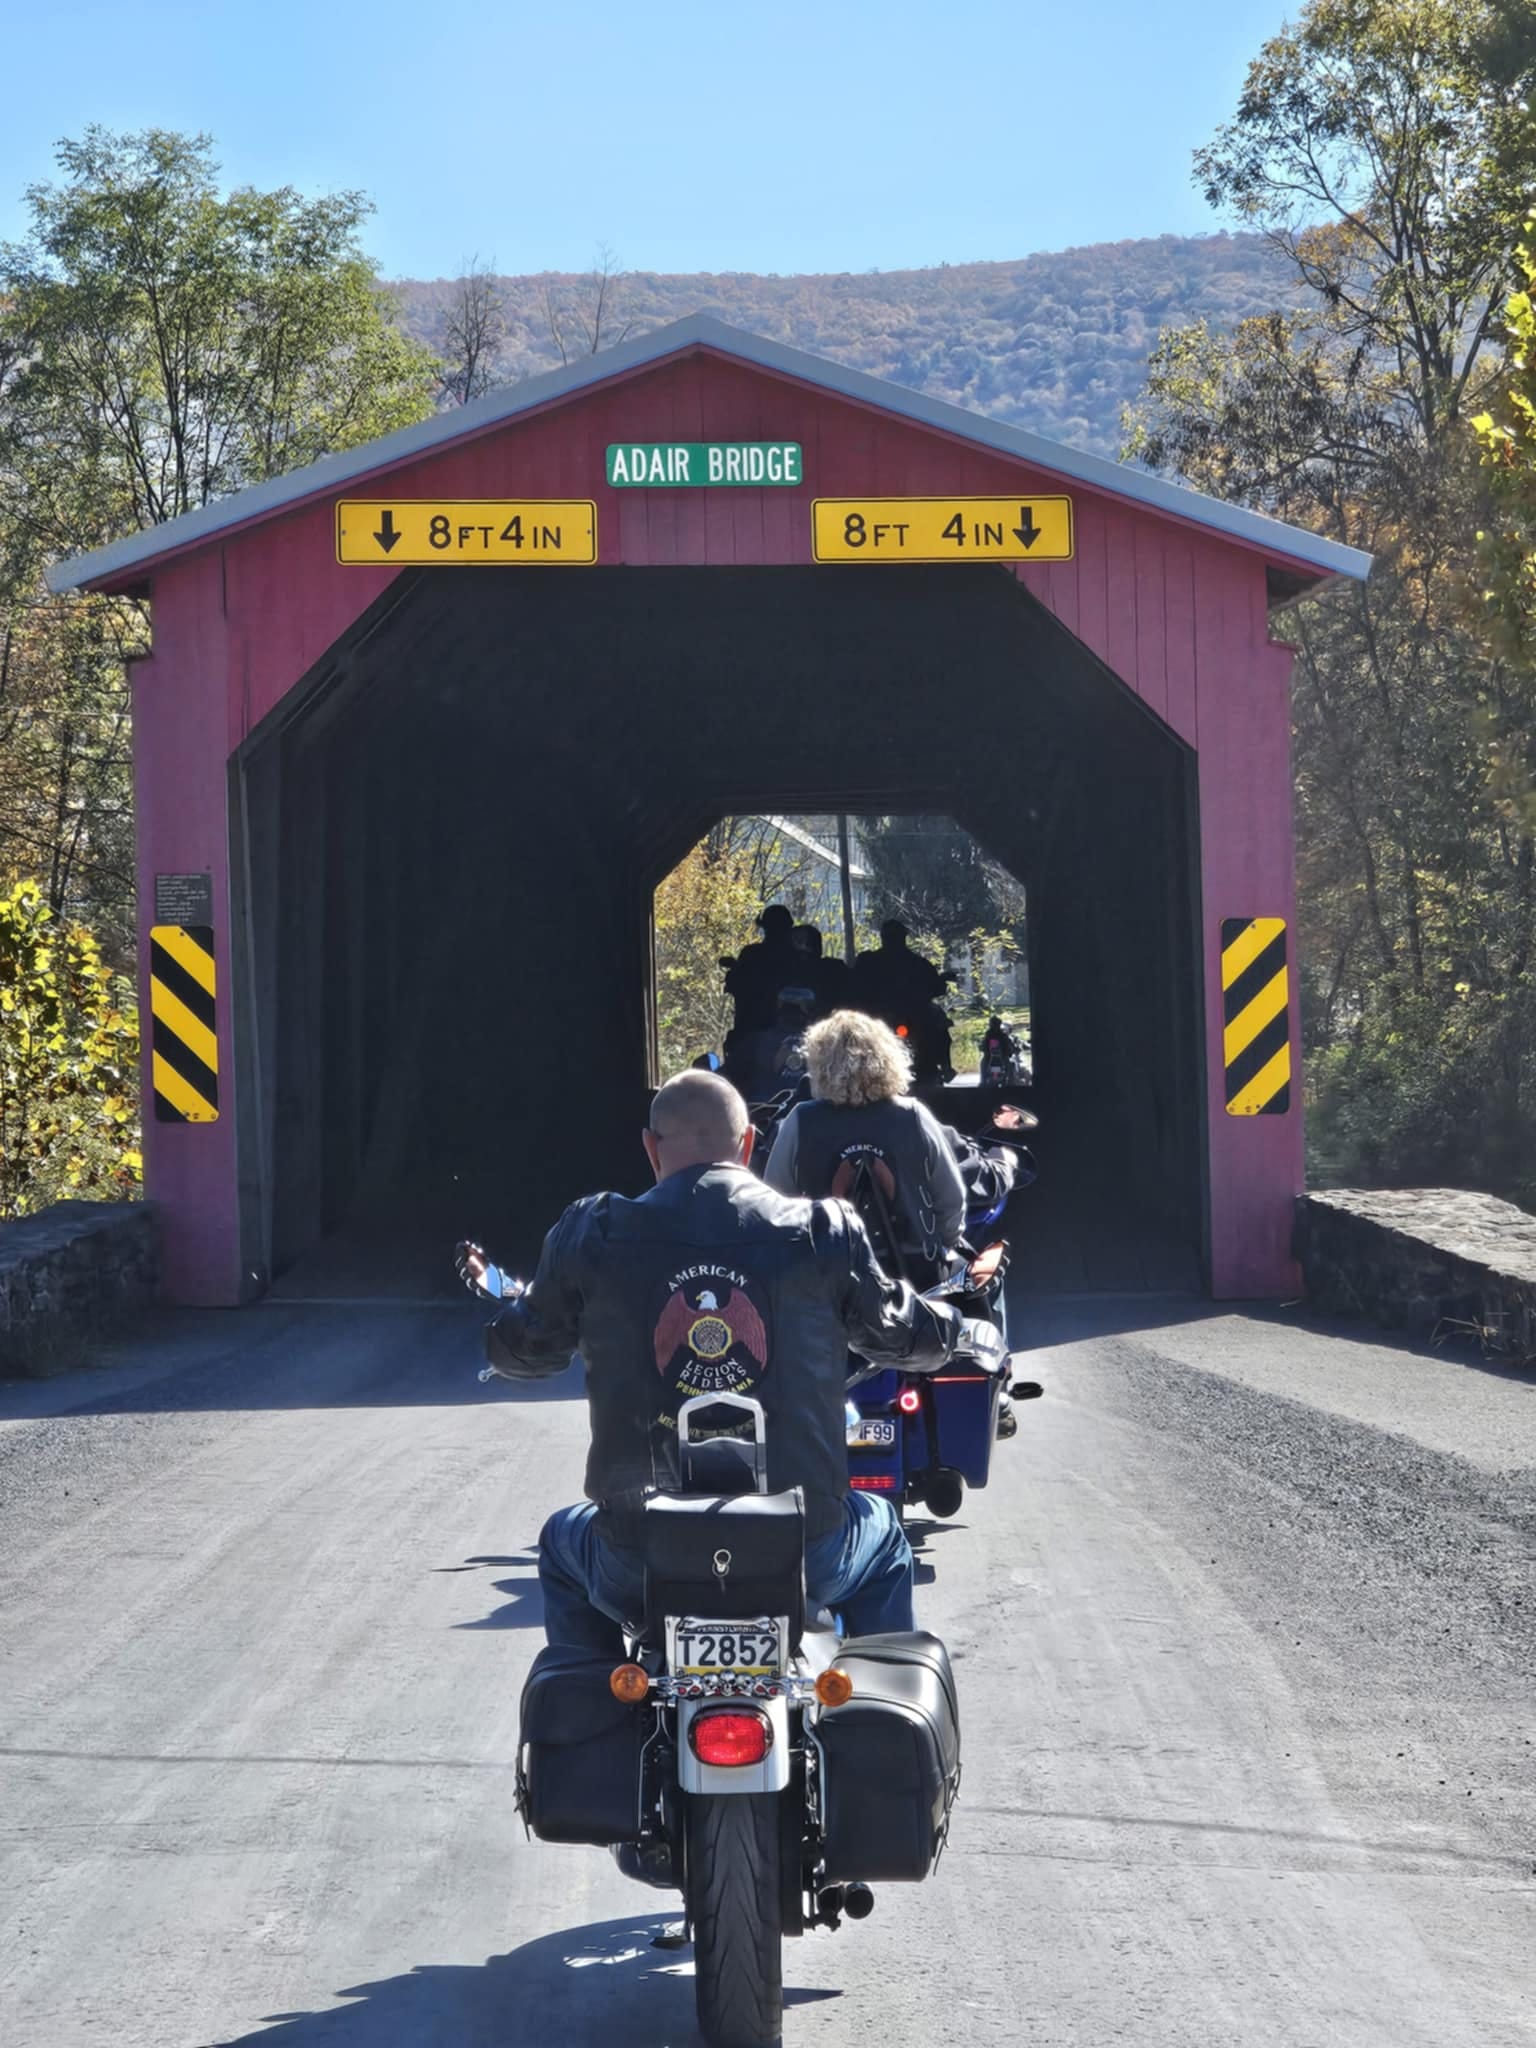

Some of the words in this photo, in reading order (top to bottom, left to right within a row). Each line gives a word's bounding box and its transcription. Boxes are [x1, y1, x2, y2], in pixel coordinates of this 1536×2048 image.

[612, 448, 690, 483] ADAIR
[708, 446, 798, 482] BRIDGE
[840, 1143, 884, 1159] AMERICAN
[667, 1264, 748, 1292] AMERICAN
[679, 1365, 747, 1389] RIDERS
[685, 1357, 740, 1378] LEGION
[677, 1635, 778, 1667] T2852
